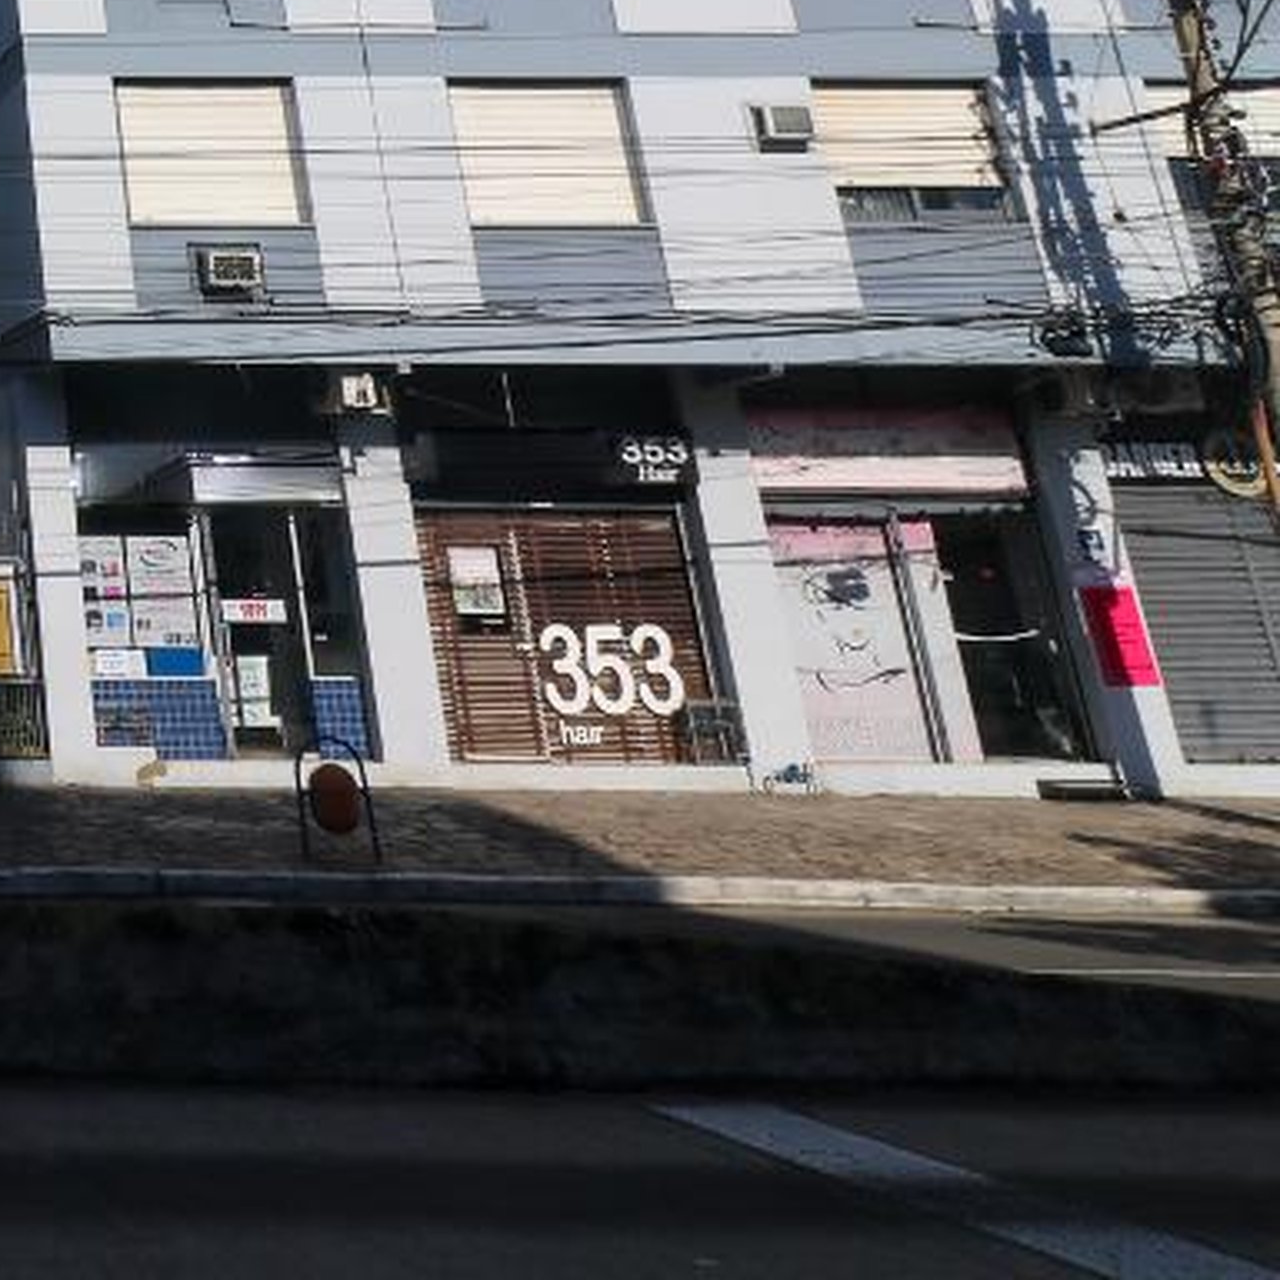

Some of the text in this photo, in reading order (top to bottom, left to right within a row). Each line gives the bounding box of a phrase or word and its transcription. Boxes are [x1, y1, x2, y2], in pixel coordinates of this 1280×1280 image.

[621, 435, 690, 465] 353
[539, 623, 685, 717] 353
[559, 719, 605, 745] hair
